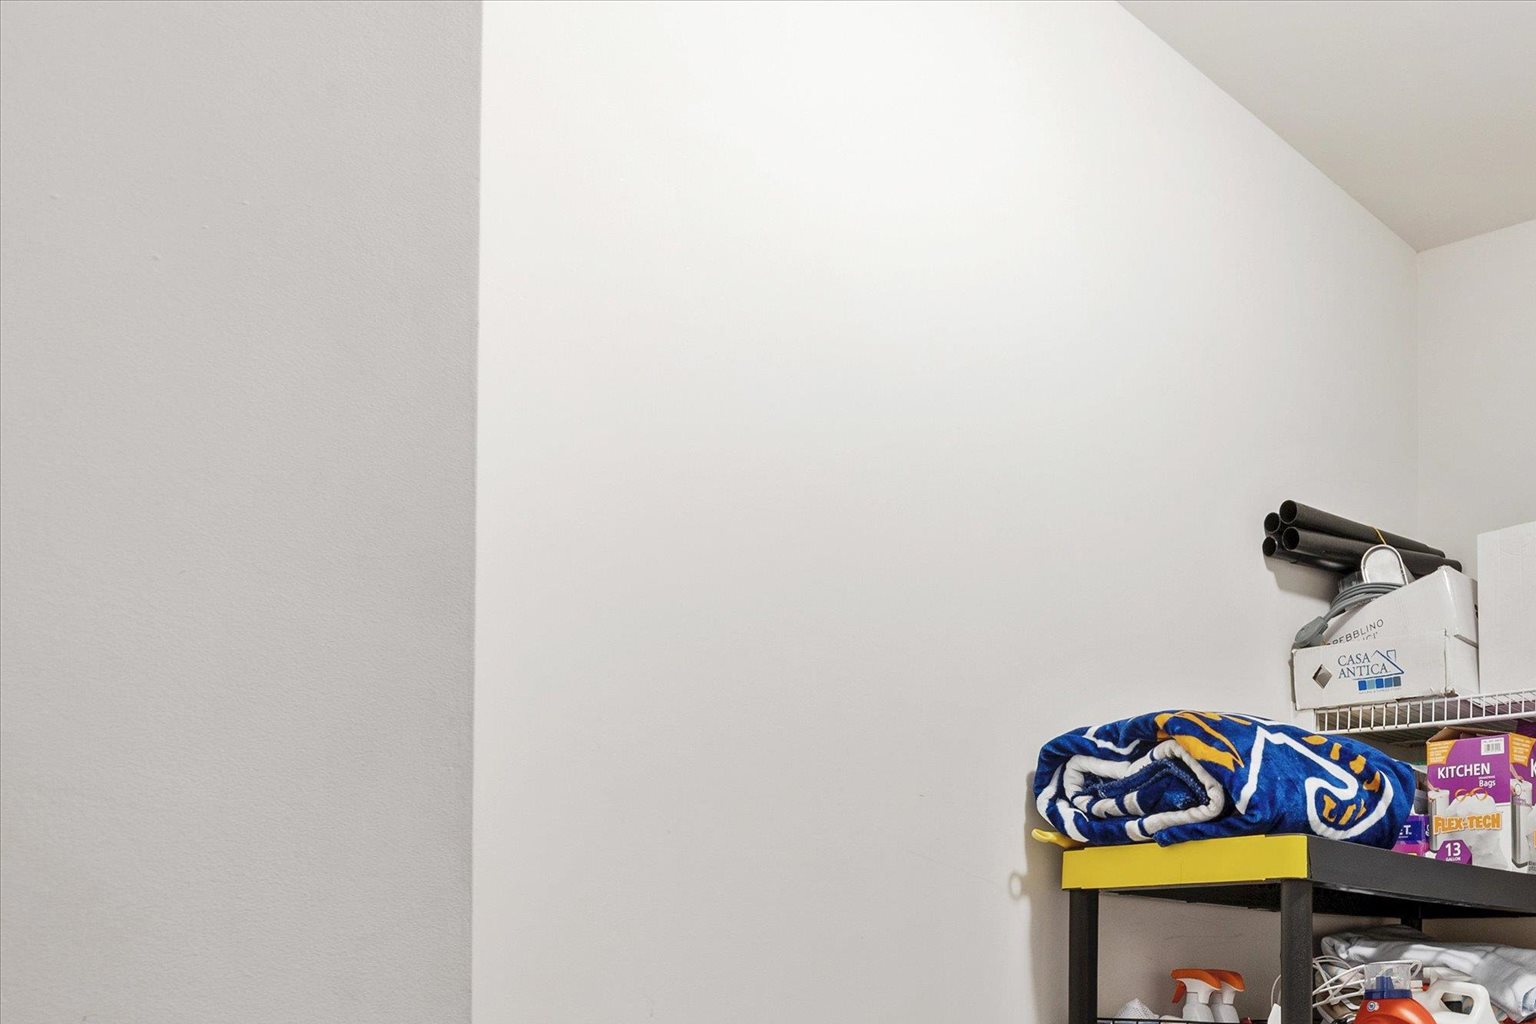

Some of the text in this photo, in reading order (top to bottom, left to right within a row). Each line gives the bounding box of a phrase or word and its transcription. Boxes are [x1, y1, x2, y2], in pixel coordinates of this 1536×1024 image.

[1337, 652, 1370, 667] CASA
[1338, 663, 1388, 679] ANTICA
[1437, 762, 1491, 779] KITCHEN
[1479, 780, 1496, 789] Bags
[1445, 842, 1461, 857] 13
